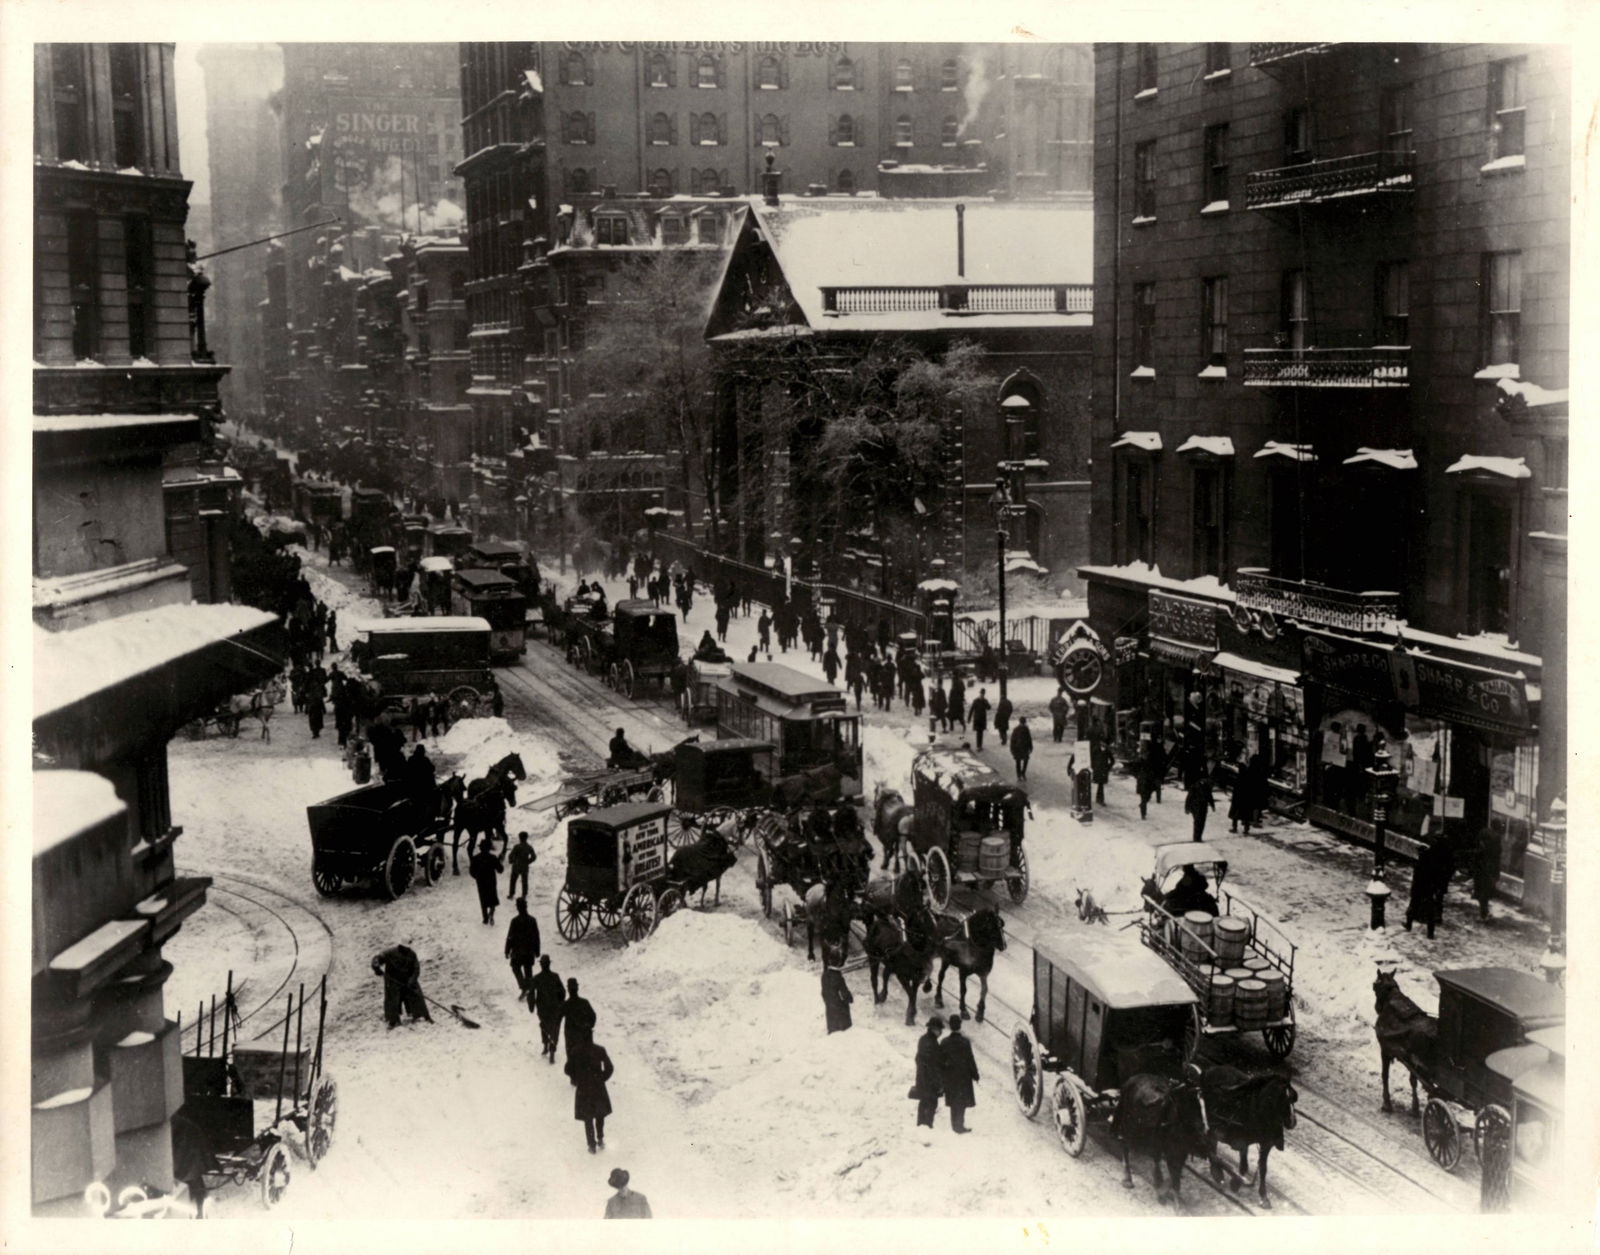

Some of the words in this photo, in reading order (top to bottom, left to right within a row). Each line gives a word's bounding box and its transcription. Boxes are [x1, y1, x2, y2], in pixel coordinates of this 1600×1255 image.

[336, 113, 419, 133] SINGER
[1322, 653, 1360, 672] SHARP
[1417, 663, 1463, 693] SHARP
[633, 834, 664, 853] AMERICAN
